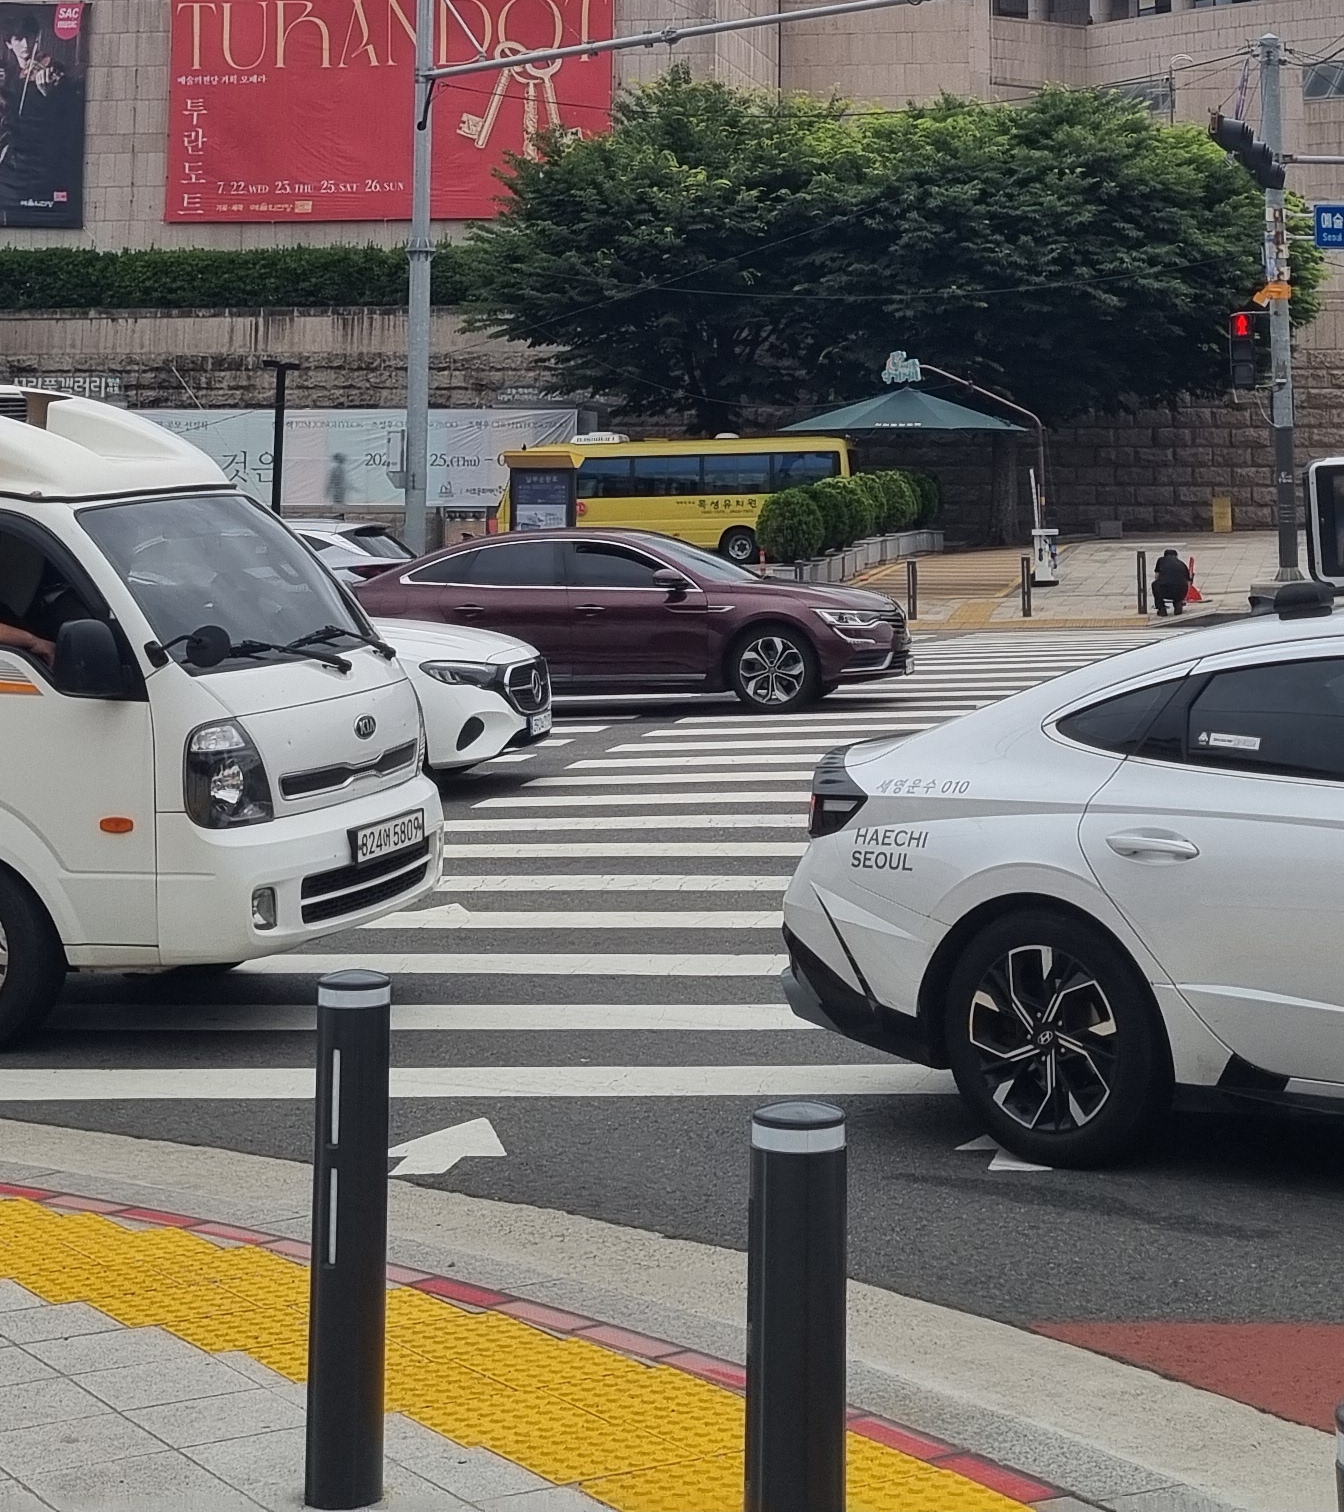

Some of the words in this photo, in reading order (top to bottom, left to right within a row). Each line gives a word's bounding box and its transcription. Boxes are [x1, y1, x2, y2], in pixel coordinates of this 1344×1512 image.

[58, 8, 80, 18] SAC
[177, 98, 208, 214] 투란도트
[1322, 232, 1343, 242] Seoul
[359, 720, 376, 736] KIA
[941, 780, 971, 794] 010
[393, 816, 420, 847] 5809
[854, 827, 929, 849] HAECHI
[851, 850, 913, 872] SEOUL
